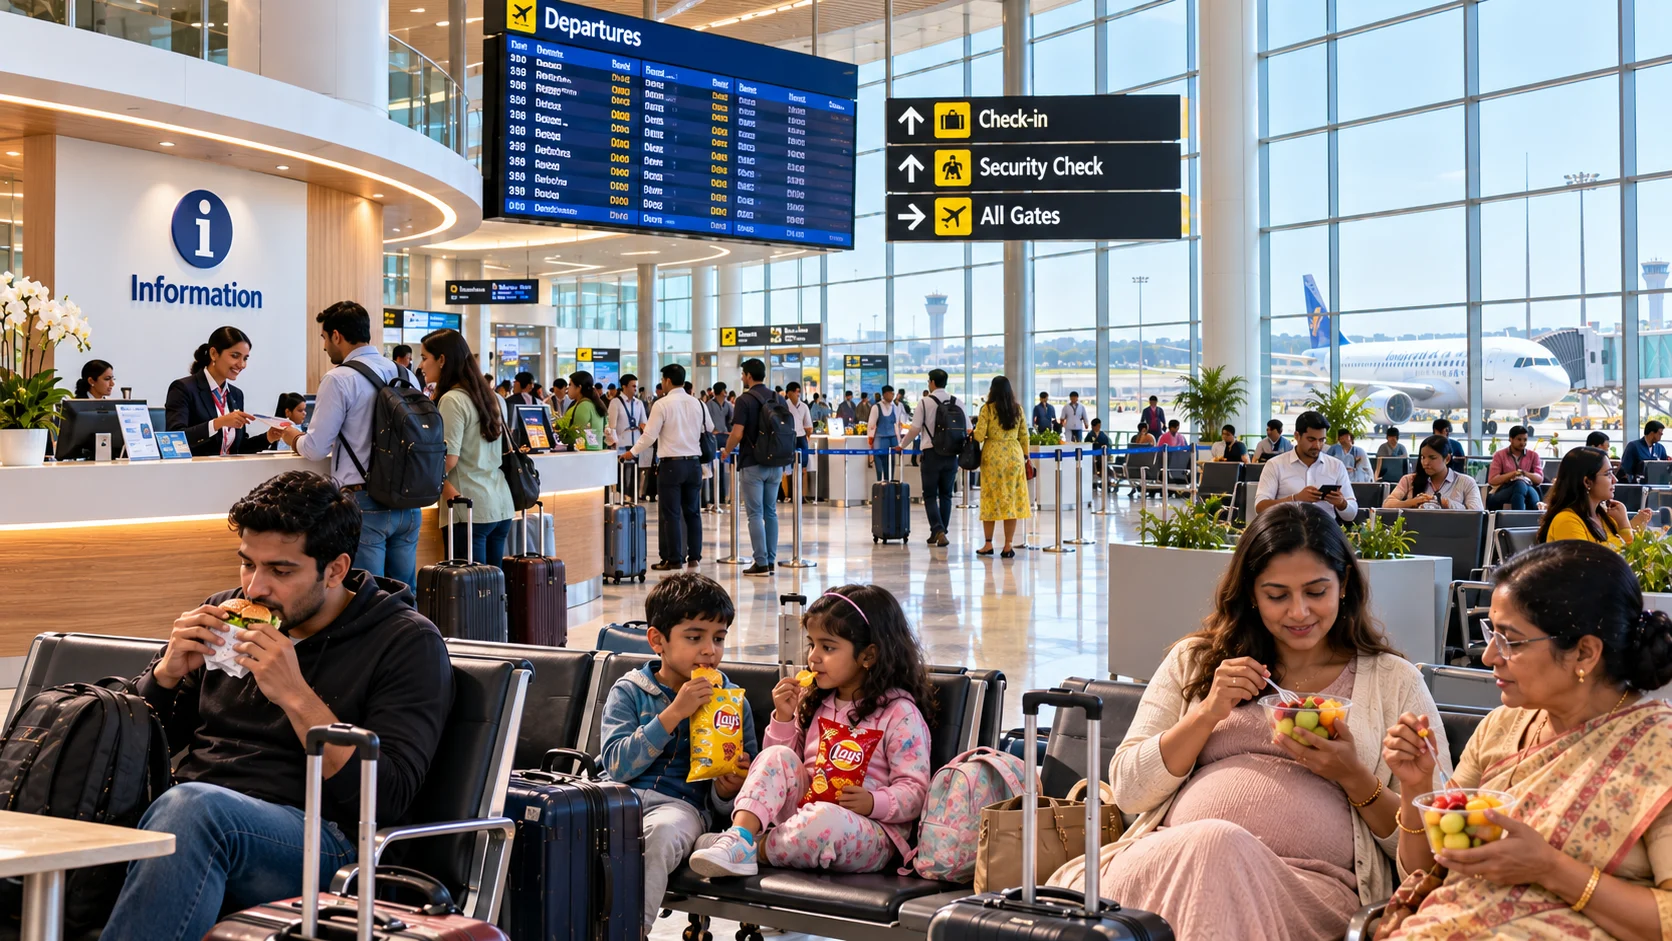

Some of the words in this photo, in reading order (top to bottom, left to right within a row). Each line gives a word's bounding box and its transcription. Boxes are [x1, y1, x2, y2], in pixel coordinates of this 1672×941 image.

[545, 6, 642, 47] Departures
[979, 109, 1048, 129] Check-in
[980, 156, 1048, 181] Security
[1053, 156, 1104, 176] Check
[980, 205, 1004, 225] All
[1011, 205, 1060, 225] Gates
[131, 274, 262, 309] Information
